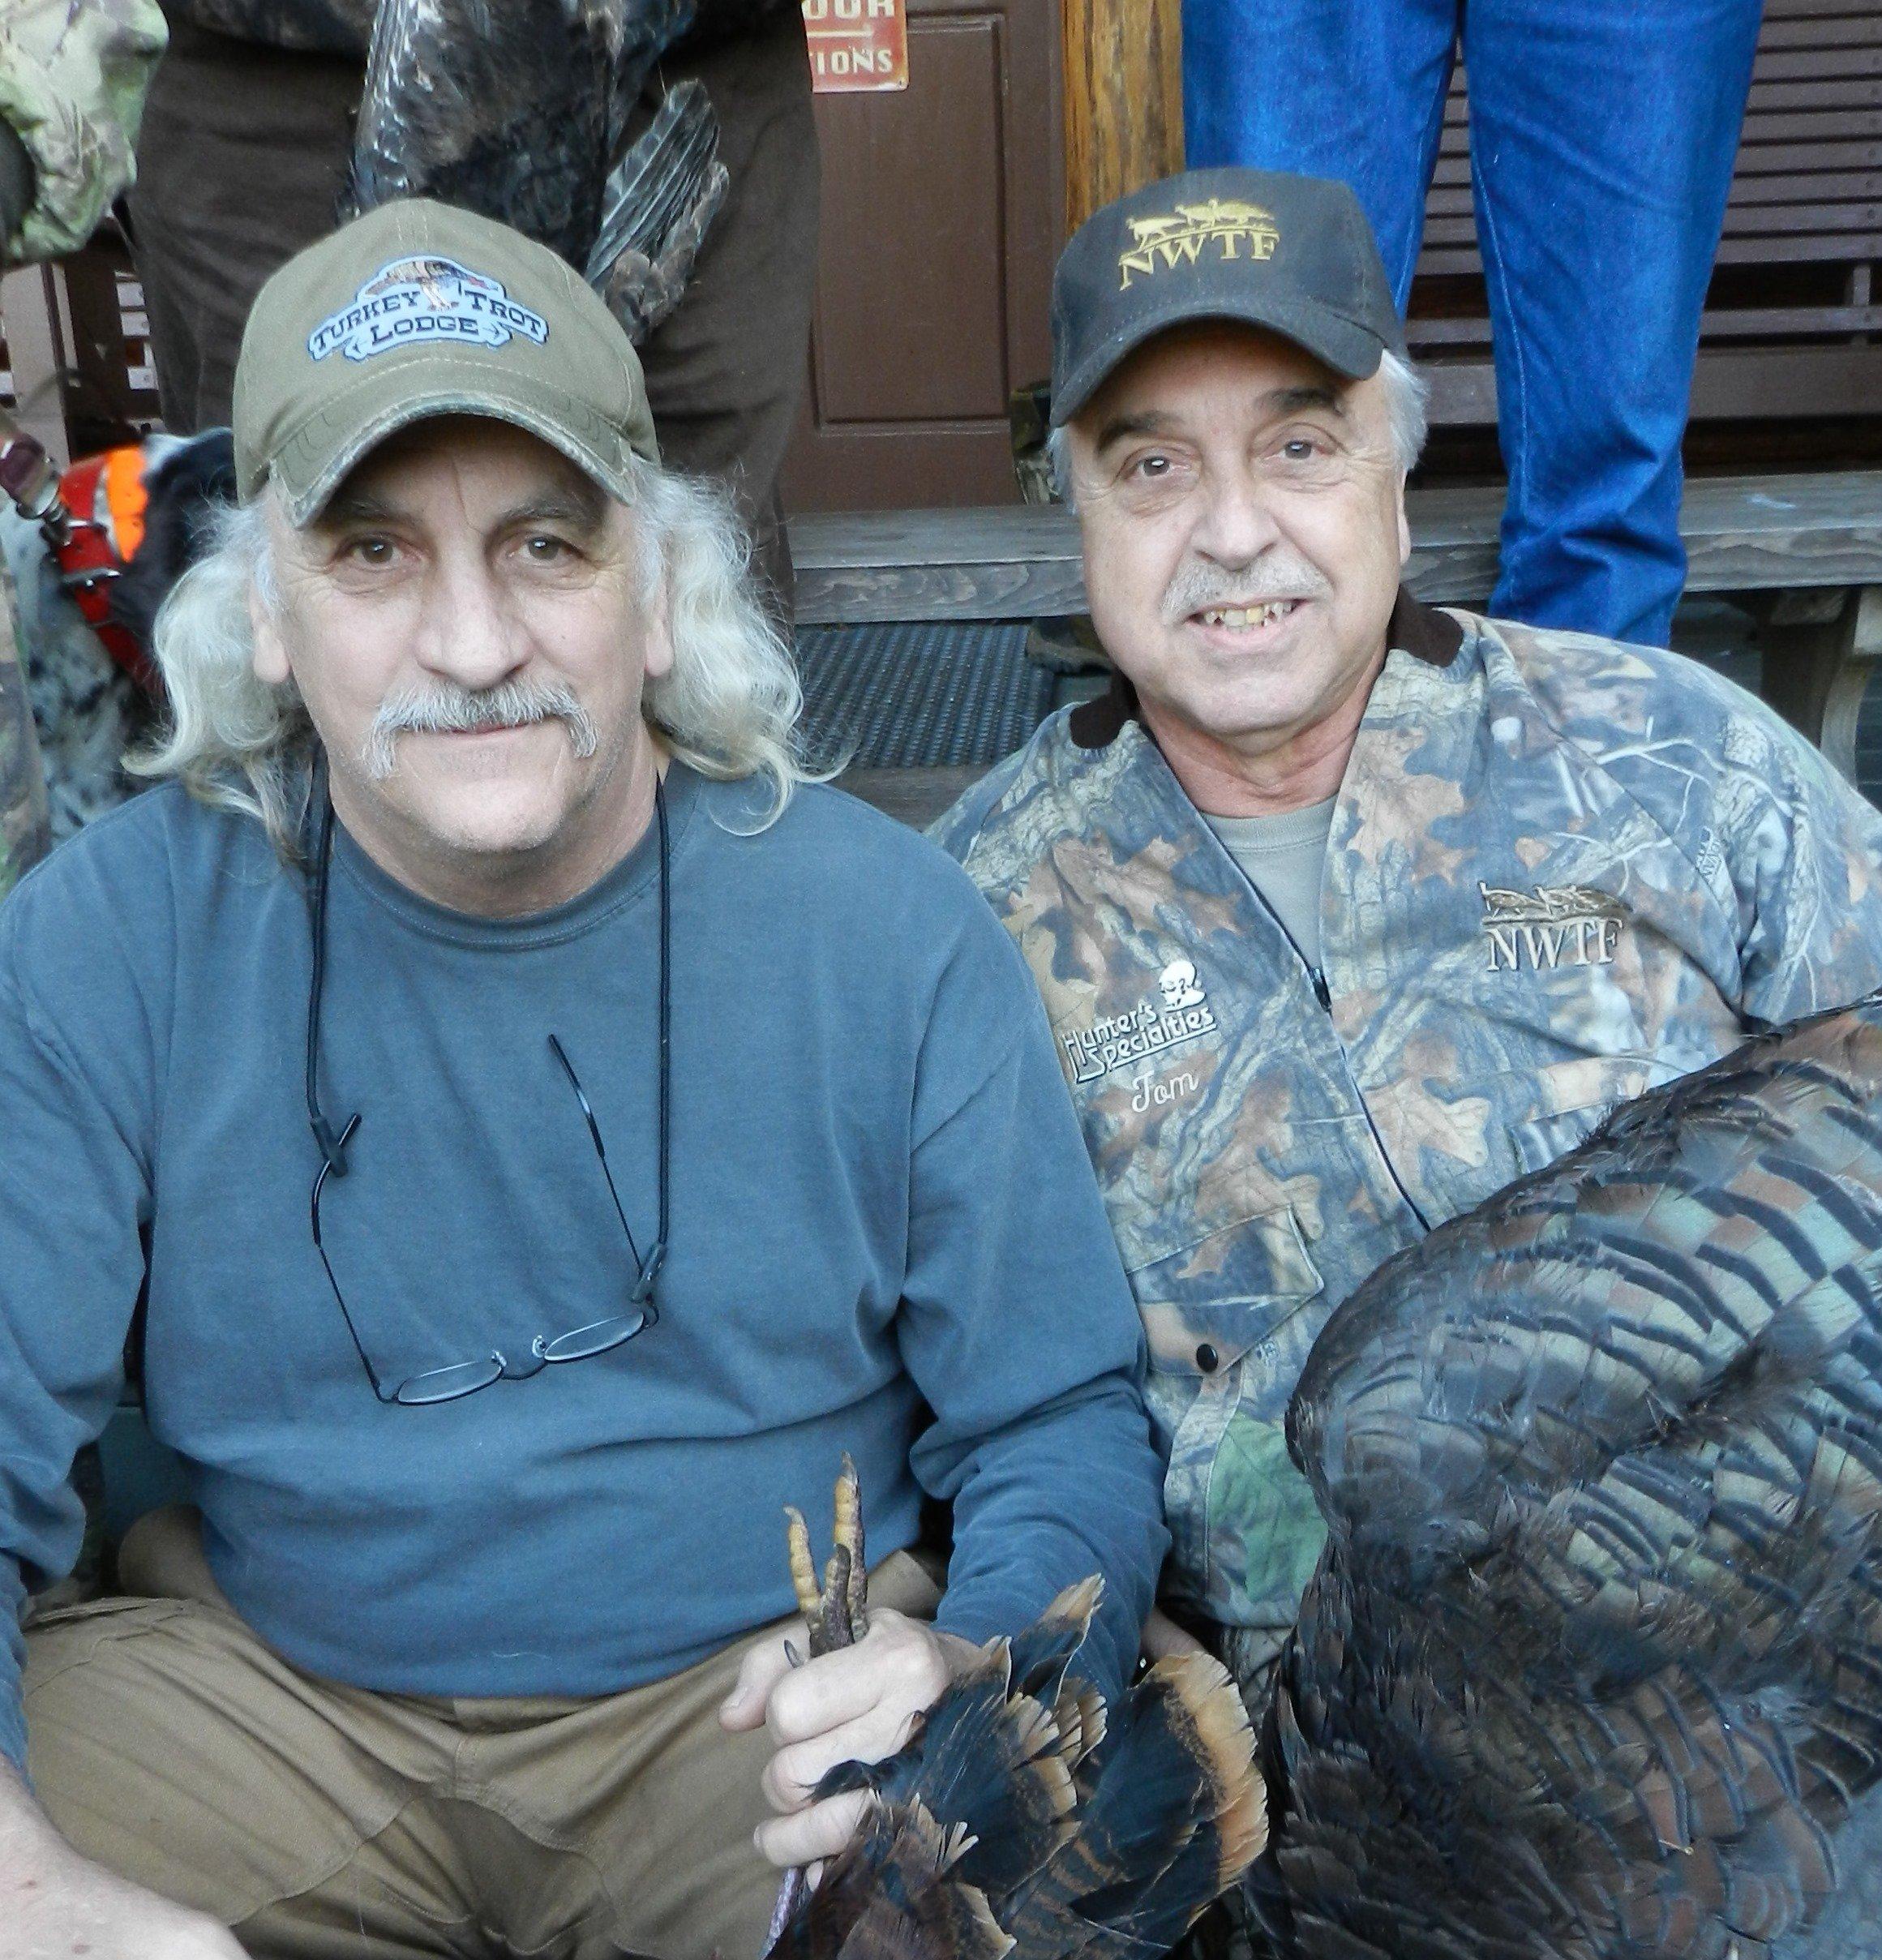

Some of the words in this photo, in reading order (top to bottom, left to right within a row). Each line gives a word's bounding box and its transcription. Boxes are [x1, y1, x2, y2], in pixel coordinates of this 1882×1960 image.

[809, 47, 892, 75] IONS
[1118, 228, 1280, 291] NWTF
[313, 290, 420, 351] TURKEY
[464, 289, 543, 335] TROT
[370, 315, 478, 345] LODGE
[1485, 917, 1623, 971] NWTF
[1062, 999, 1157, 1069] Hunter's
[1082, 1007, 1215, 1079] Specialties
[1132, 1070, 1198, 1113] Tom
